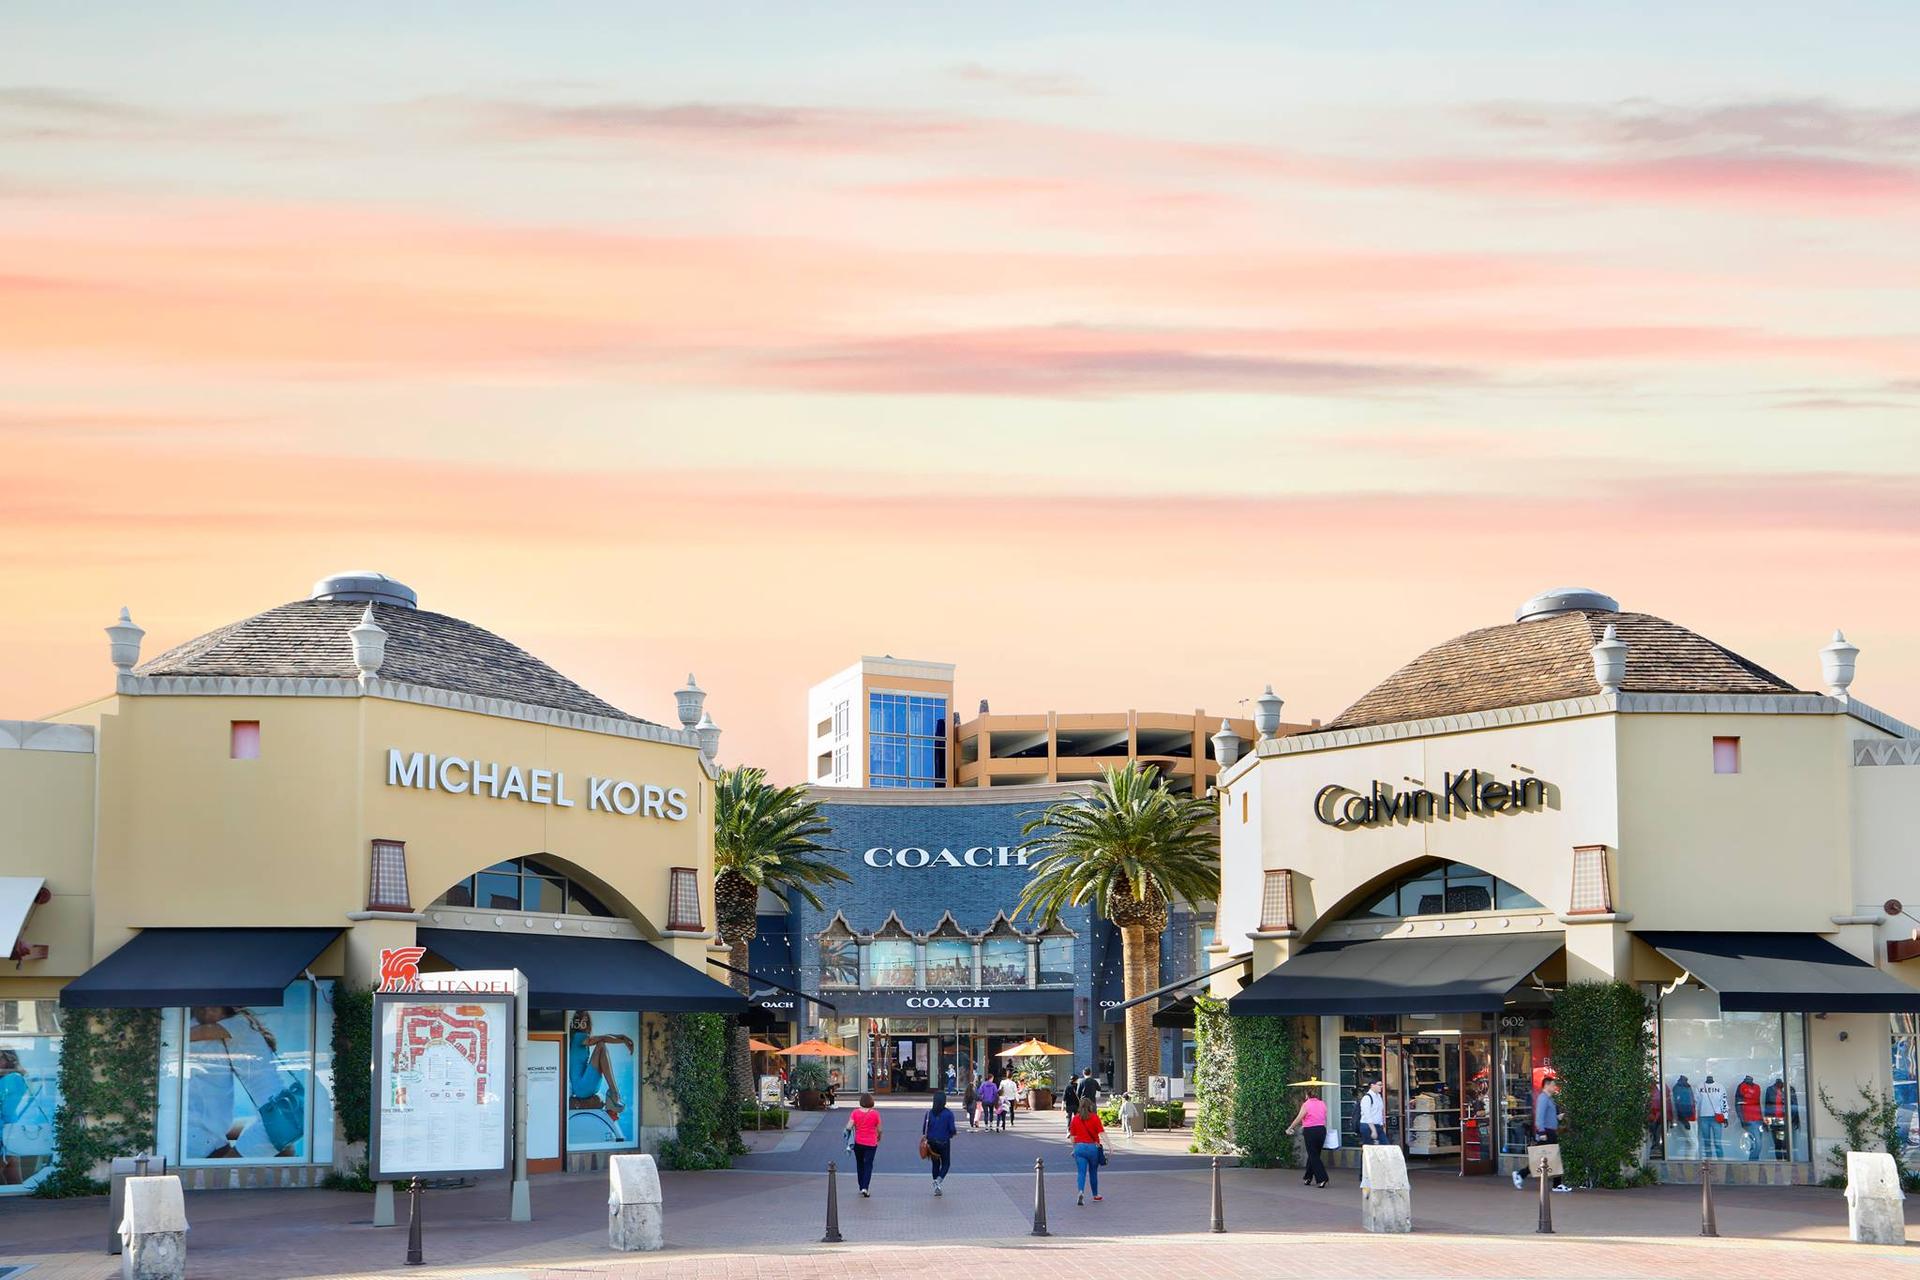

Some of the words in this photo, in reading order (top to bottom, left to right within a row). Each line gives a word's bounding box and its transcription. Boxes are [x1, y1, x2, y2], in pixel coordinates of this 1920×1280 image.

[387, 748, 575, 808] MICHAEL
[587, 776, 689, 822] KORS
[1314, 776, 1434, 826] Calvin
[1444, 763, 1544, 815] Klein
[863, 846, 1029, 868] COACH
[419, 980, 513, 994] CITADEL
[761, 1001, 794, 1009] OACH
[906, 997, 990, 1008] COACH
[1502, 1016, 1525, 1028] 602
